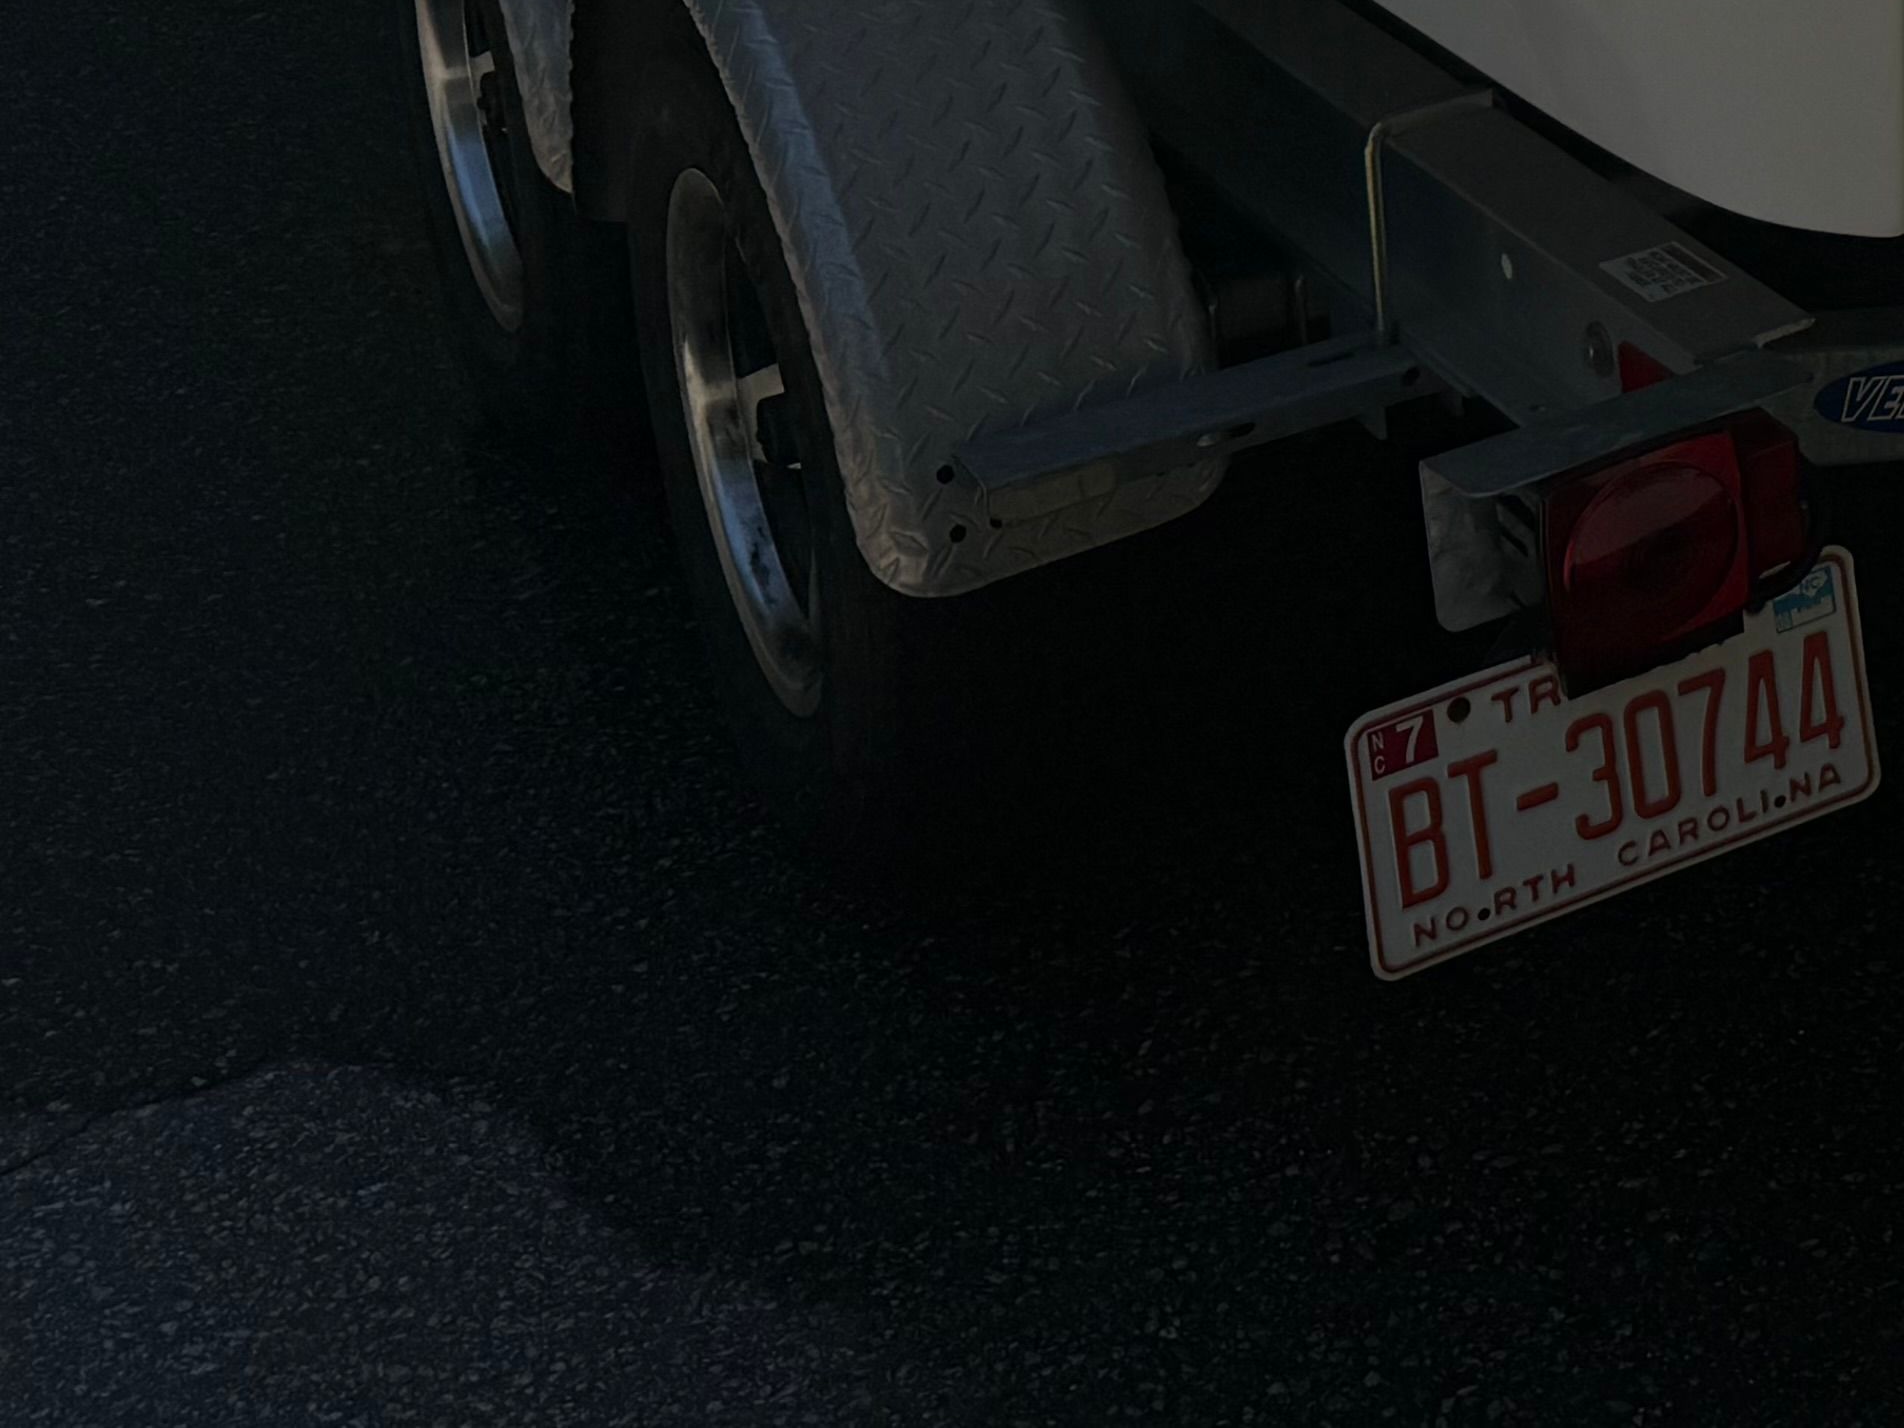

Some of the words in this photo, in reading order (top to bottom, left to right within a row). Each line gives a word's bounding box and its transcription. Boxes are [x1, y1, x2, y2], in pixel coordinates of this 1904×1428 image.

[1388, 631, 1844, 908] BT-30744
[1394, 714, 1424, 765] 7
[1414, 864, 1576, 946] NORTH
[1618, 764, 1841, 865] CAROLINA
